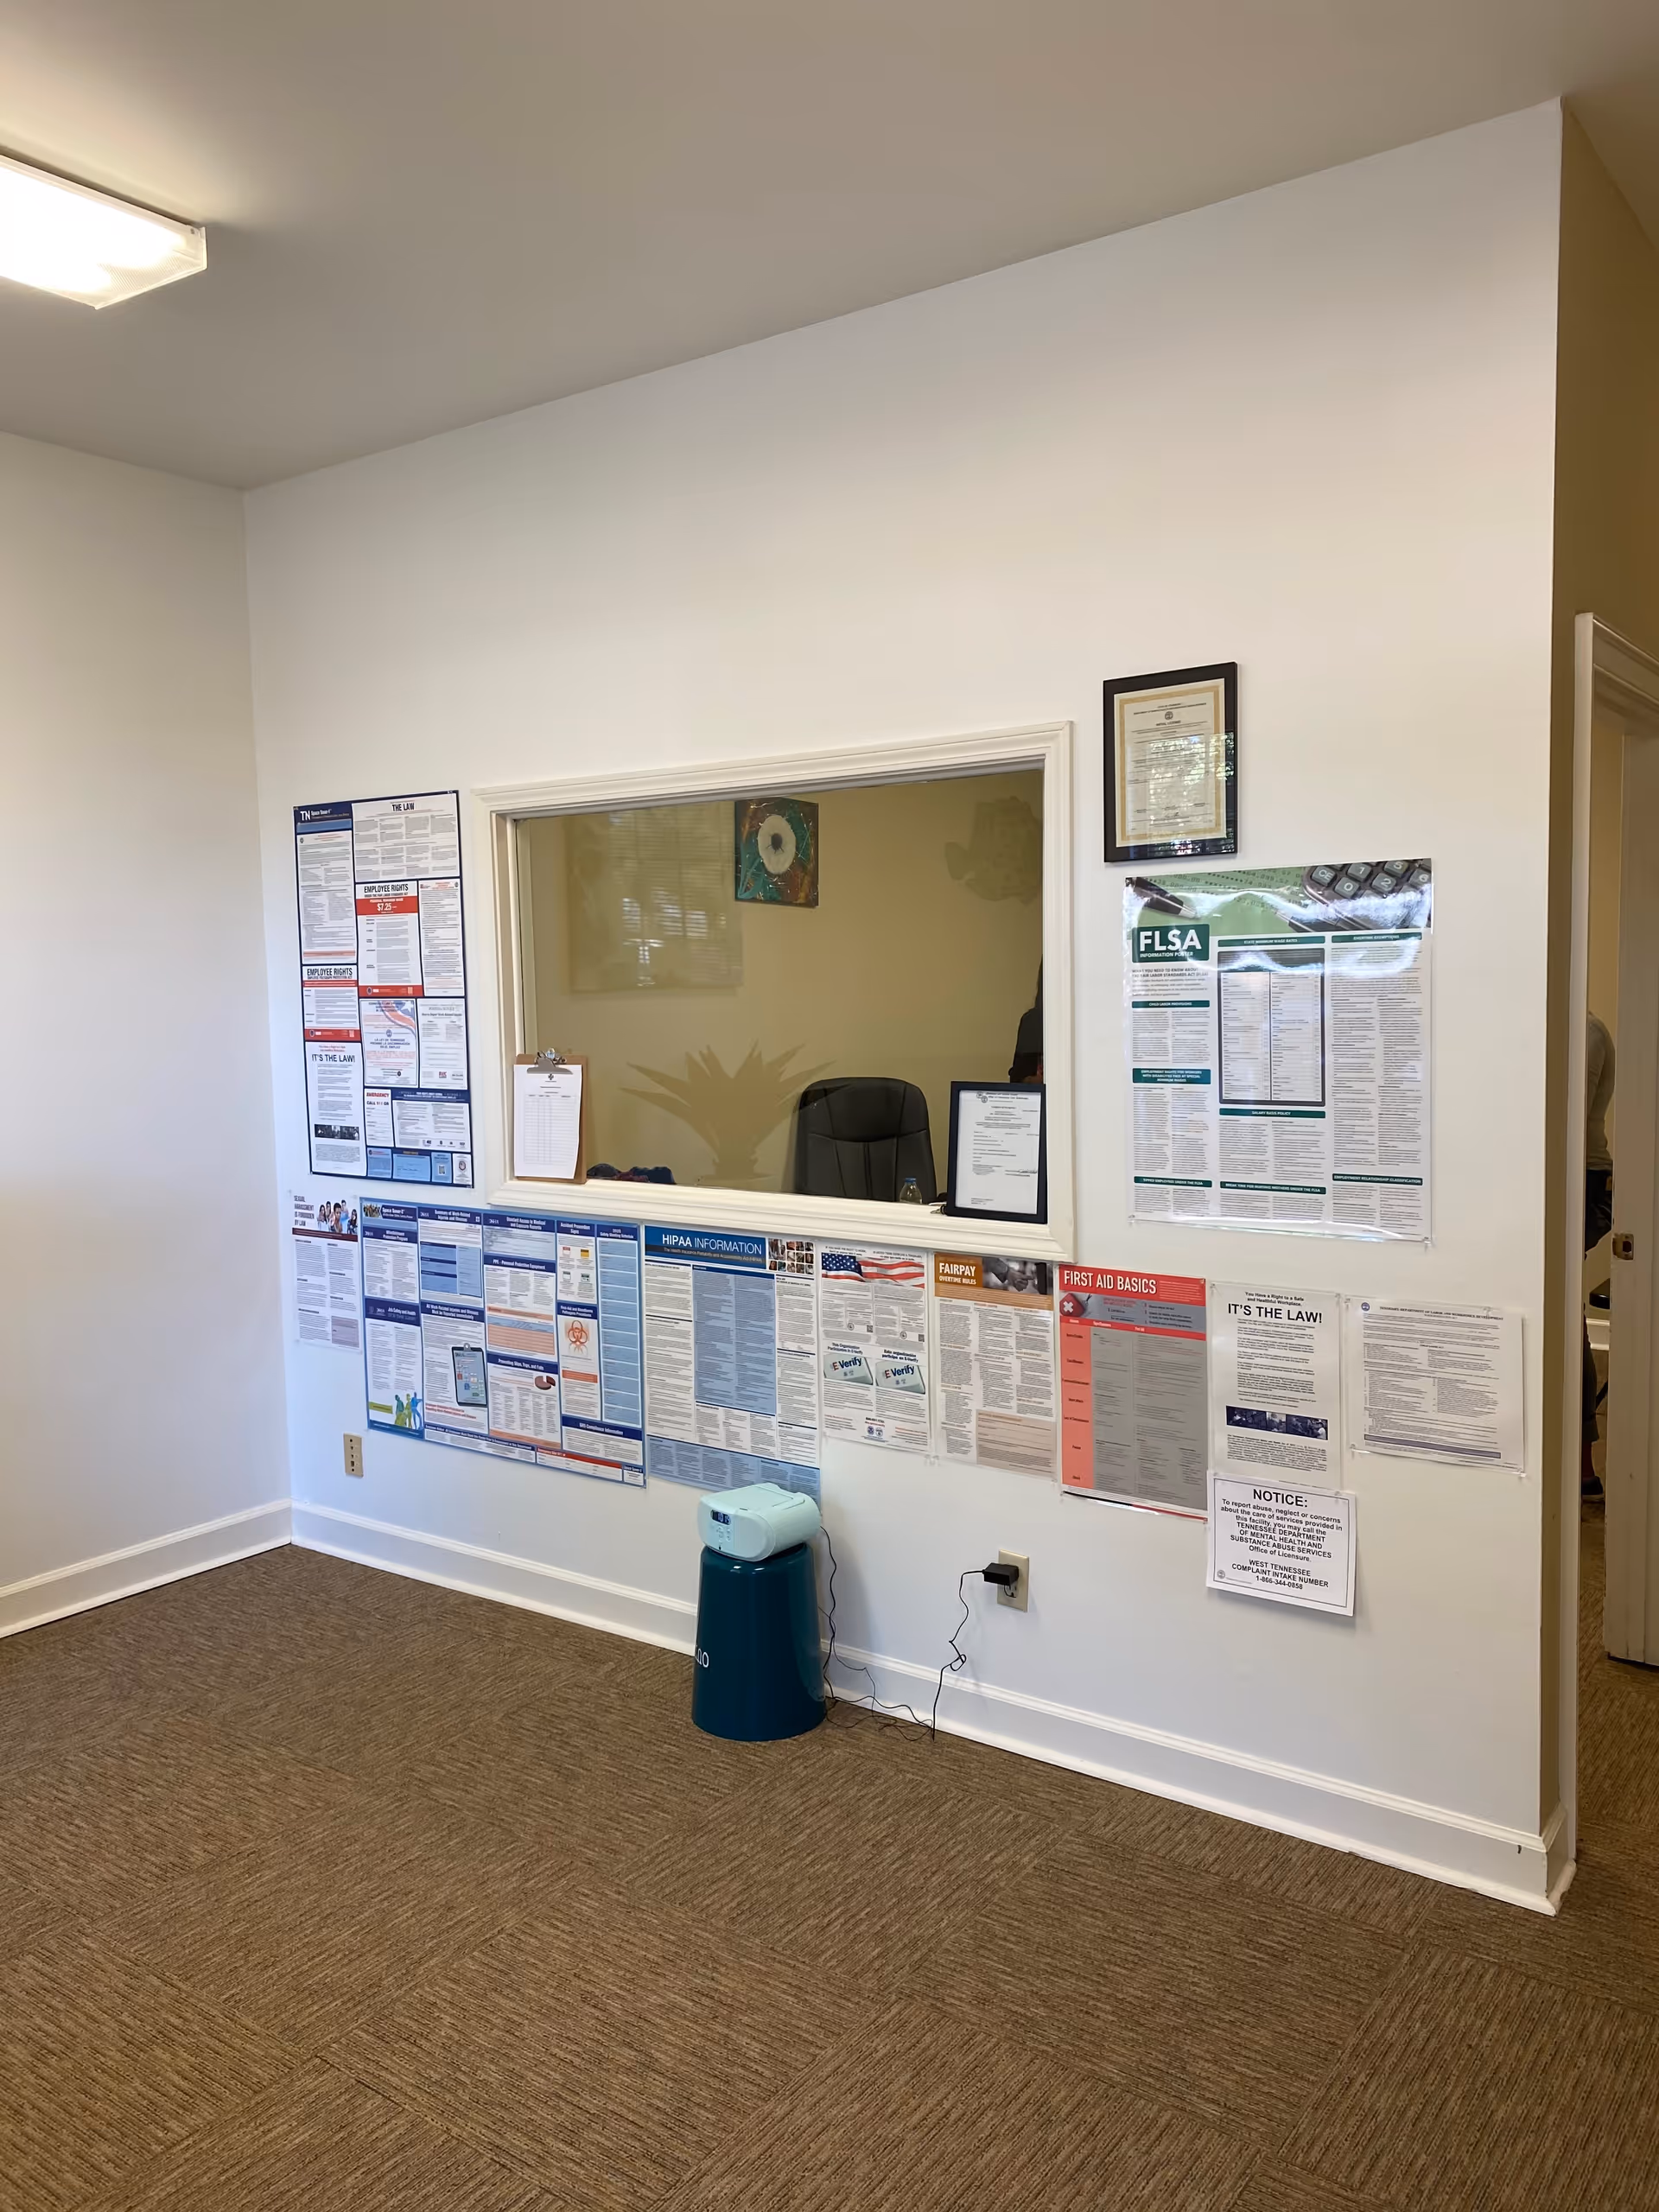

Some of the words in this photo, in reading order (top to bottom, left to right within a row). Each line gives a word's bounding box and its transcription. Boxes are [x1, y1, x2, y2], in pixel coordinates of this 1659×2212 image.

[300, 810, 310, 821] TN
[1319, 869, 1334, 880] CE
[1381, 878, 1392, 887] 2
[1140, 929, 1202, 951] FLSA
[334, 967, 353, 976] RIGHTS
[339, 1054, 355, 1063] LAW!
[662, 1234, 692, 1247] HIPAA
[695, 1237, 761, 1255] INFORMATION
[939, 1262, 976, 1276] FAIRPAY
[1064, 1270, 1093, 1287] FIRST
[1096, 1274, 1114, 1289] AID
[1117, 1275, 1156, 1294] BASICS
[1255, 1306, 1282, 1319] THE
[1287, 1309, 1322, 1324] LAW!
[839, 1357, 862, 1369] Verify
[891, 1365, 915, 1377] Verify
[1253, 1489, 1308, 1508] NOTICE:
[1220, 1505, 1239, 1514] about
[1275, 1514, 1304, 1525] services
[1305, 1518, 1334, 1529] provided
[1252, 1503, 1274, 1513] abuse,
[1275, 1507, 1300, 1517] neglect
[1309, 1514, 1341, 1523] concerns
[1236, 1522, 1277, 1535] TENNESSEE
[1278, 1529, 1325, 1542] DEPARTMENT
[1287, 1524, 1301, 1533] may
[1230, 1535, 1271, 1548] SUBSTANCE
[1272, 1541, 1296, 1553] ABUSE
[1297, 1547, 1332, 1559] SERVICES
[1250, 1531, 1278, 1541] MENTAL
[1279, 1535, 1306, 1547] HEALTH
[1307, 1541, 1323, 1549] AND
[1249, 1545, 1268, 1554] Office
[1277, 1550, 1312, 1562] Licensure.
[1231, 1563, 1272, 1577] COMPLAINT
[1272, 1571, 1297, 1582] INTAKE
[1299, 1576, 1329, 1588] NUMBER
[1249, 1559, 1268, 1568] WEST
[1270, 1563, 1311, 1577] TENNESSEE
